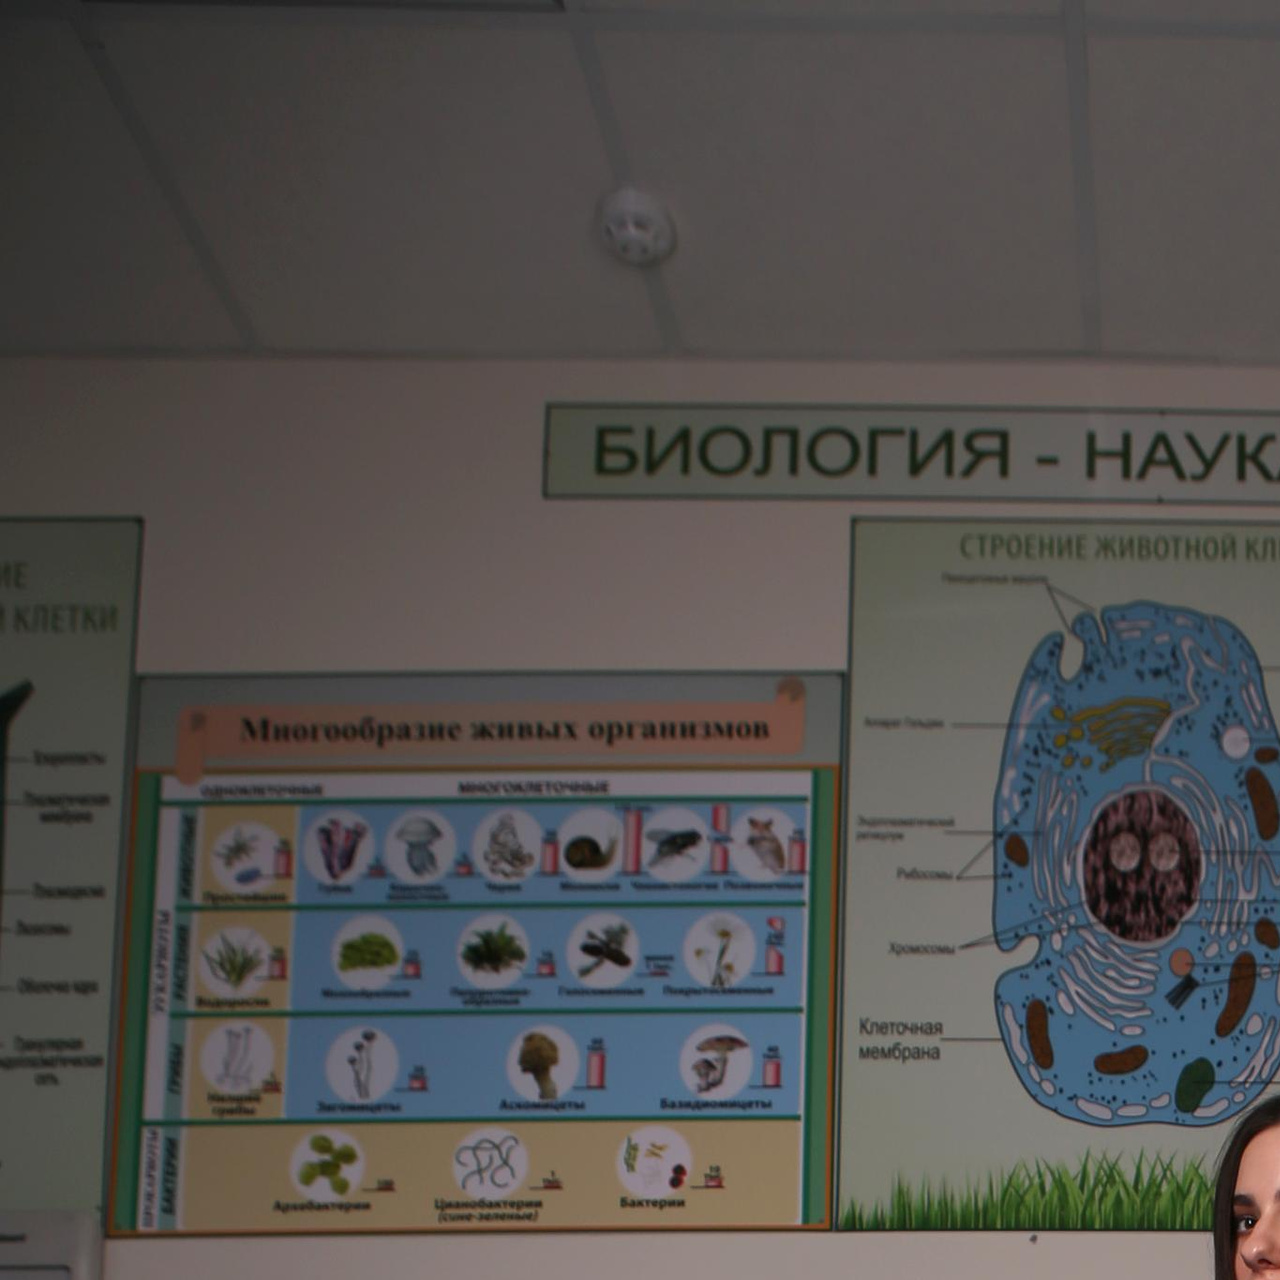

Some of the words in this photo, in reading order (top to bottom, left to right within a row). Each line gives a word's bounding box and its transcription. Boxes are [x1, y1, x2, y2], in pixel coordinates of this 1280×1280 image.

[594, 424, 1011, 480] БИОЛОГИЯ
[958, 533, 1088, 563] СТРОЕНИЕ
[1095, 532, 1238, 564] ЖИВОТНОЙ
[13, 602, 119, 635] КЛЕТКИ
[238, 713, 463, 749] Многообразие
[469, 719, 580, 741] живых
[587, 719, 771, 748] организмов
[458, 780, 611, 796] МНОГОКЛЕТОЧНЫЕ
[857, 1017, 945, 1037] Клеточная
[857, 1042, 942, 1064] мембрана
[619, 1196, 686, 1209] Бактерии
